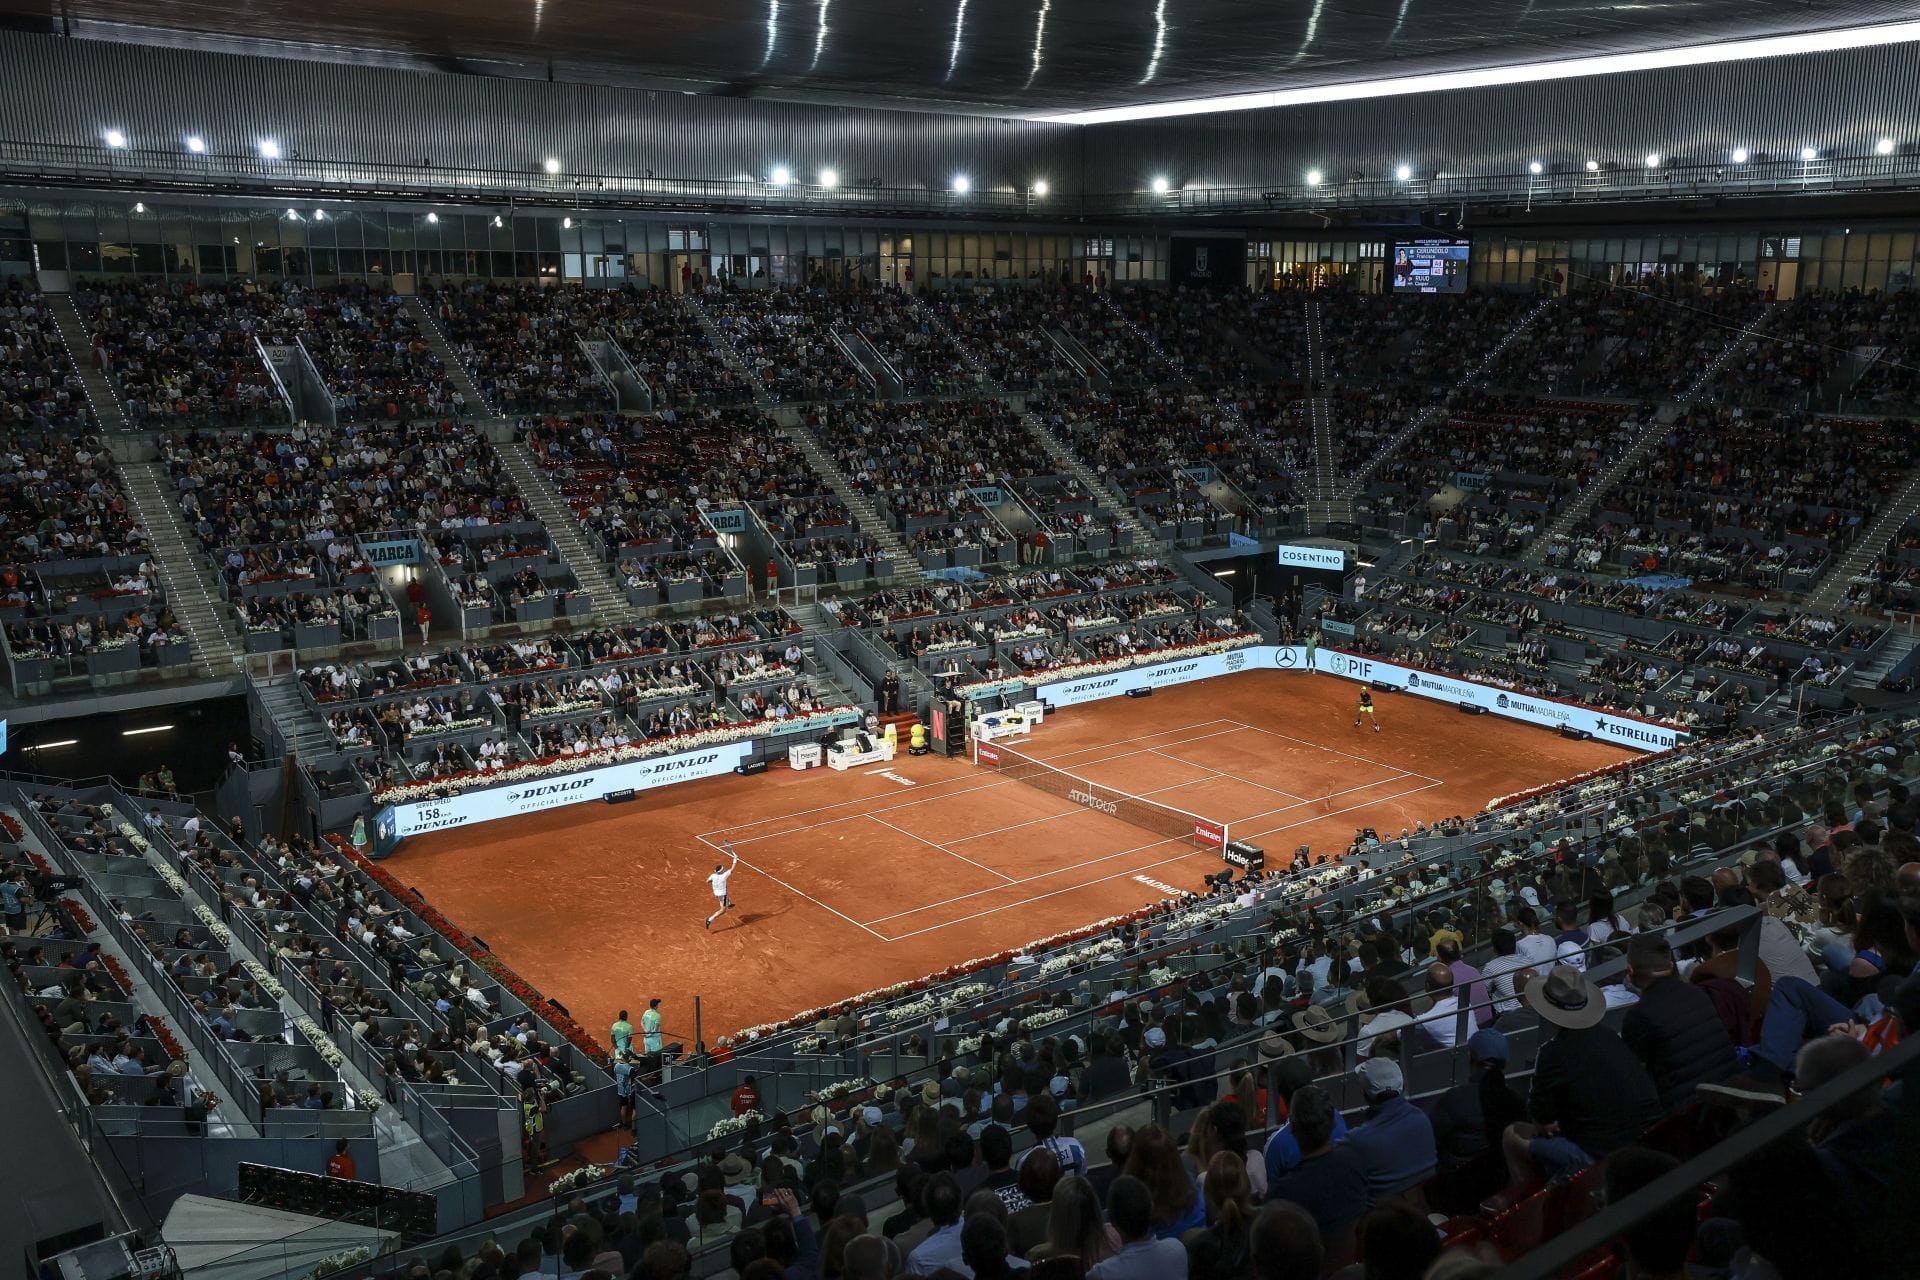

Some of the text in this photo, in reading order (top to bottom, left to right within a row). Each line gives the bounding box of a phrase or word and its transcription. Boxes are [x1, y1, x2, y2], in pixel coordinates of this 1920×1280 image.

[366, 545, 414, 562] MARCA
[1282, 551, 1341, 565] COSENTINO
[1226, 652, 1244, 661] MUTUA
[1156, 663, 1198, 677] DUNLOP
[1349, 660, 1373, 678] PIF
[1072, 679, 1119, 693] DUNLOP
[1070, 693, 1096, 702] OFFICIAL
[1510, 700, 1571, 721] MUTUAMADRILEÑA
[1609, 724, 1675, 748] ESTRELLA DA
[653, 754, 719, 774] DUNLOP
[651, 769, 709, 785] OFFICIAL BALL
[522, 778, 594, 799] DUNLOP
[415, 798, 451, 809] SERVE SPEED
[520, 793, 584, 810] OFFICIAL BALL
[1068, 789, 1117, 815] ATP TOUR
[418, 808, 440, 821] 158
[413, 815, 468, 832] DUNLOP
[1195, 826, 1221, 842] Emirates
[1227, 850, 1249, 865] Haier
[1133, 875, 1181, 895] MADRID
